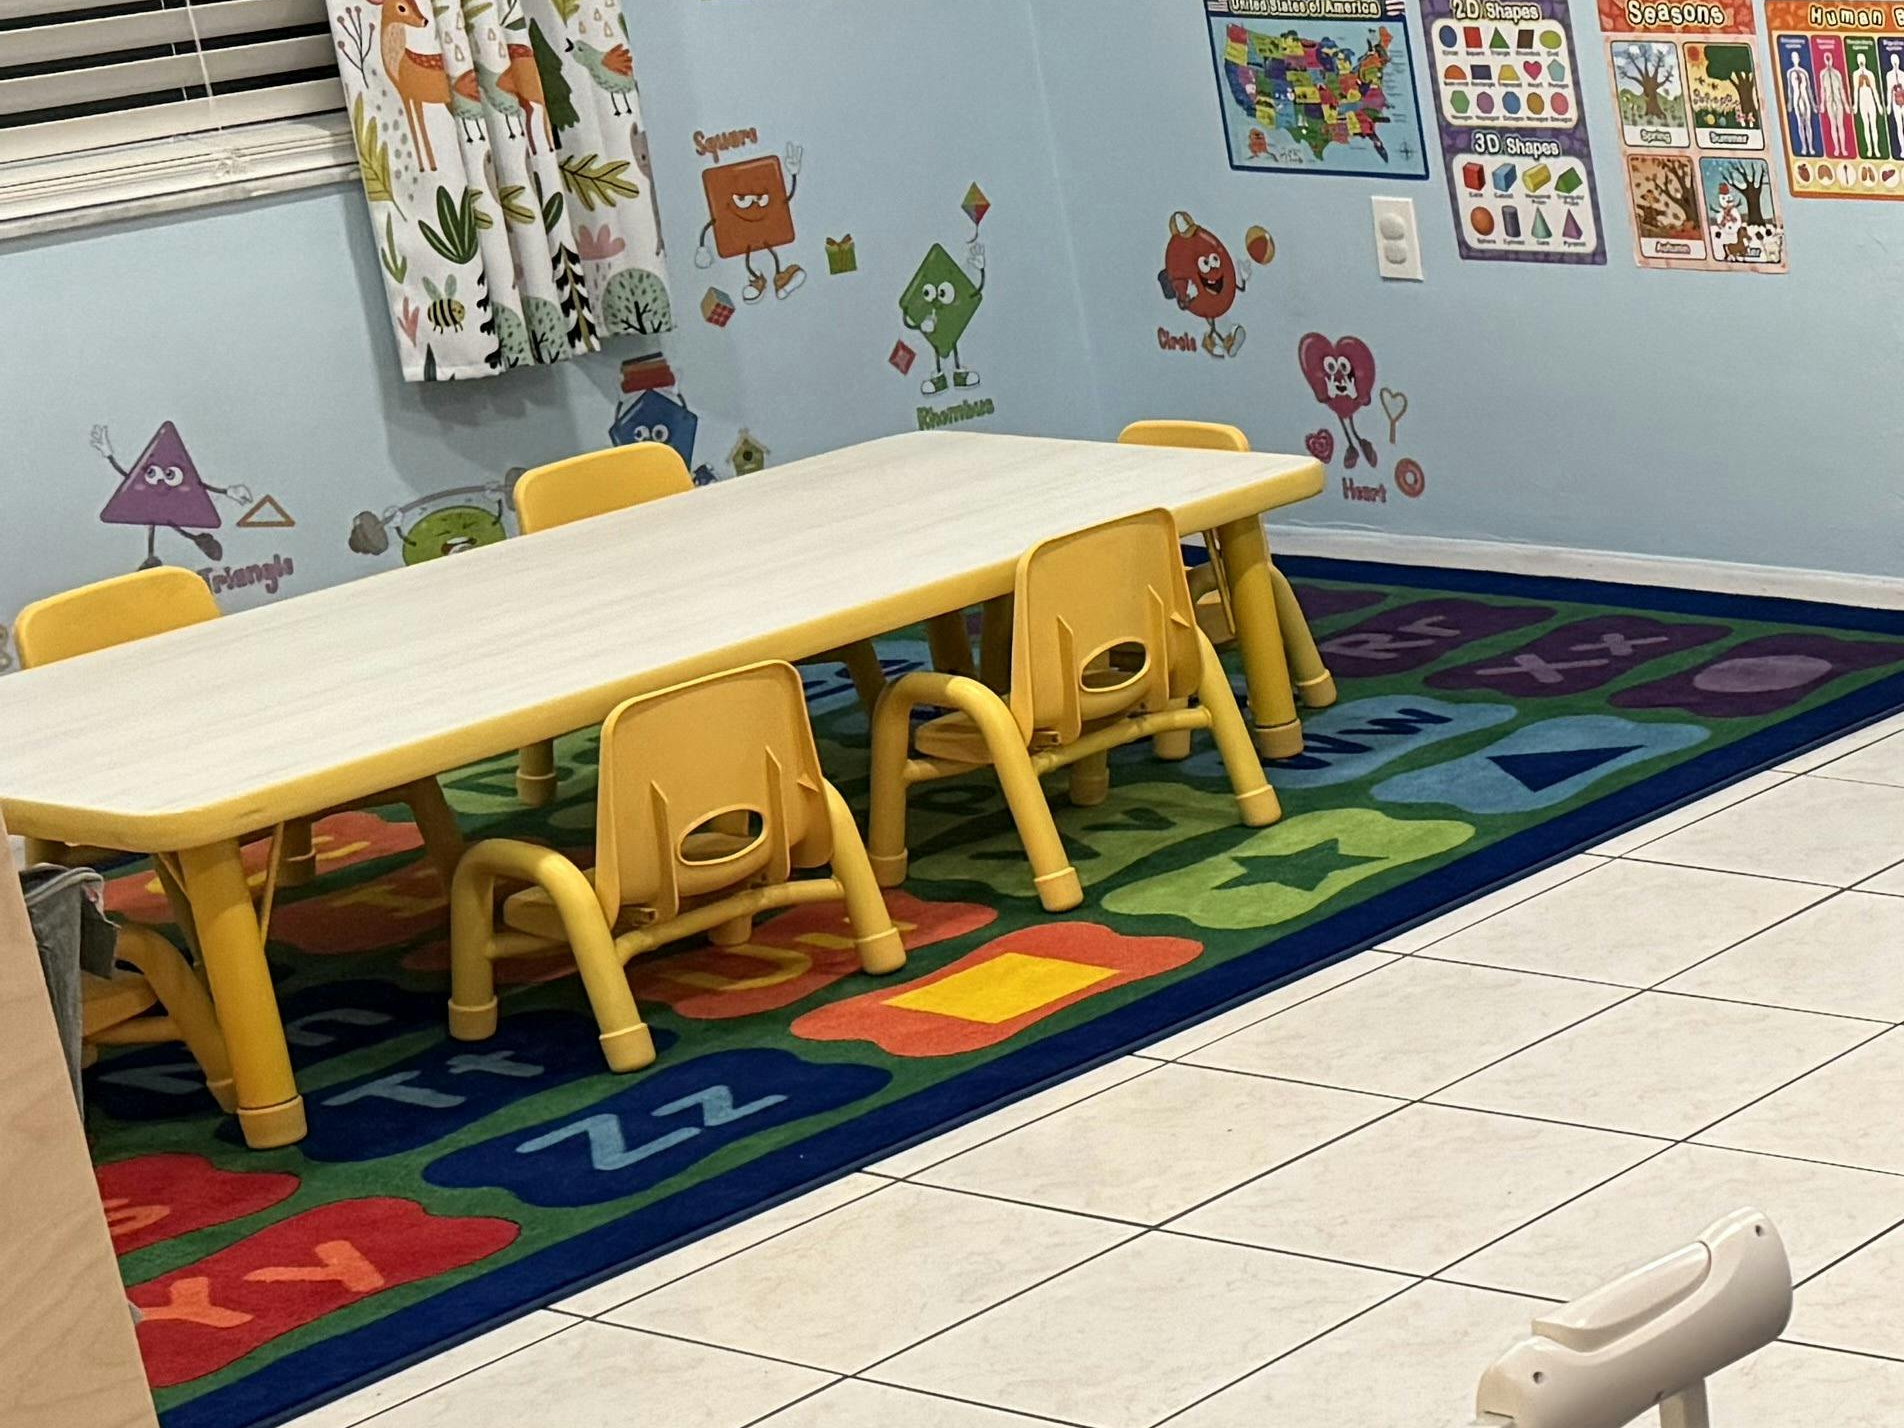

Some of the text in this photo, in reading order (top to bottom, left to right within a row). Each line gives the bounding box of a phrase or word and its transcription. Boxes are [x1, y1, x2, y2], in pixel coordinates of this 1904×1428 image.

[1485, 0, 1540, 24] Shapes
[1810, 5, 1883, 27] Human
[693, 126, 758, 156] Square
[1474, 132, 1560, 160] 3D Shapes
[1157, 327, 1197, 353] Circle
[916, 396, 995, 431] Rhombus
[1342, 478, 1387, 504] Heart
[202, 554, 294, 596] Triangle
